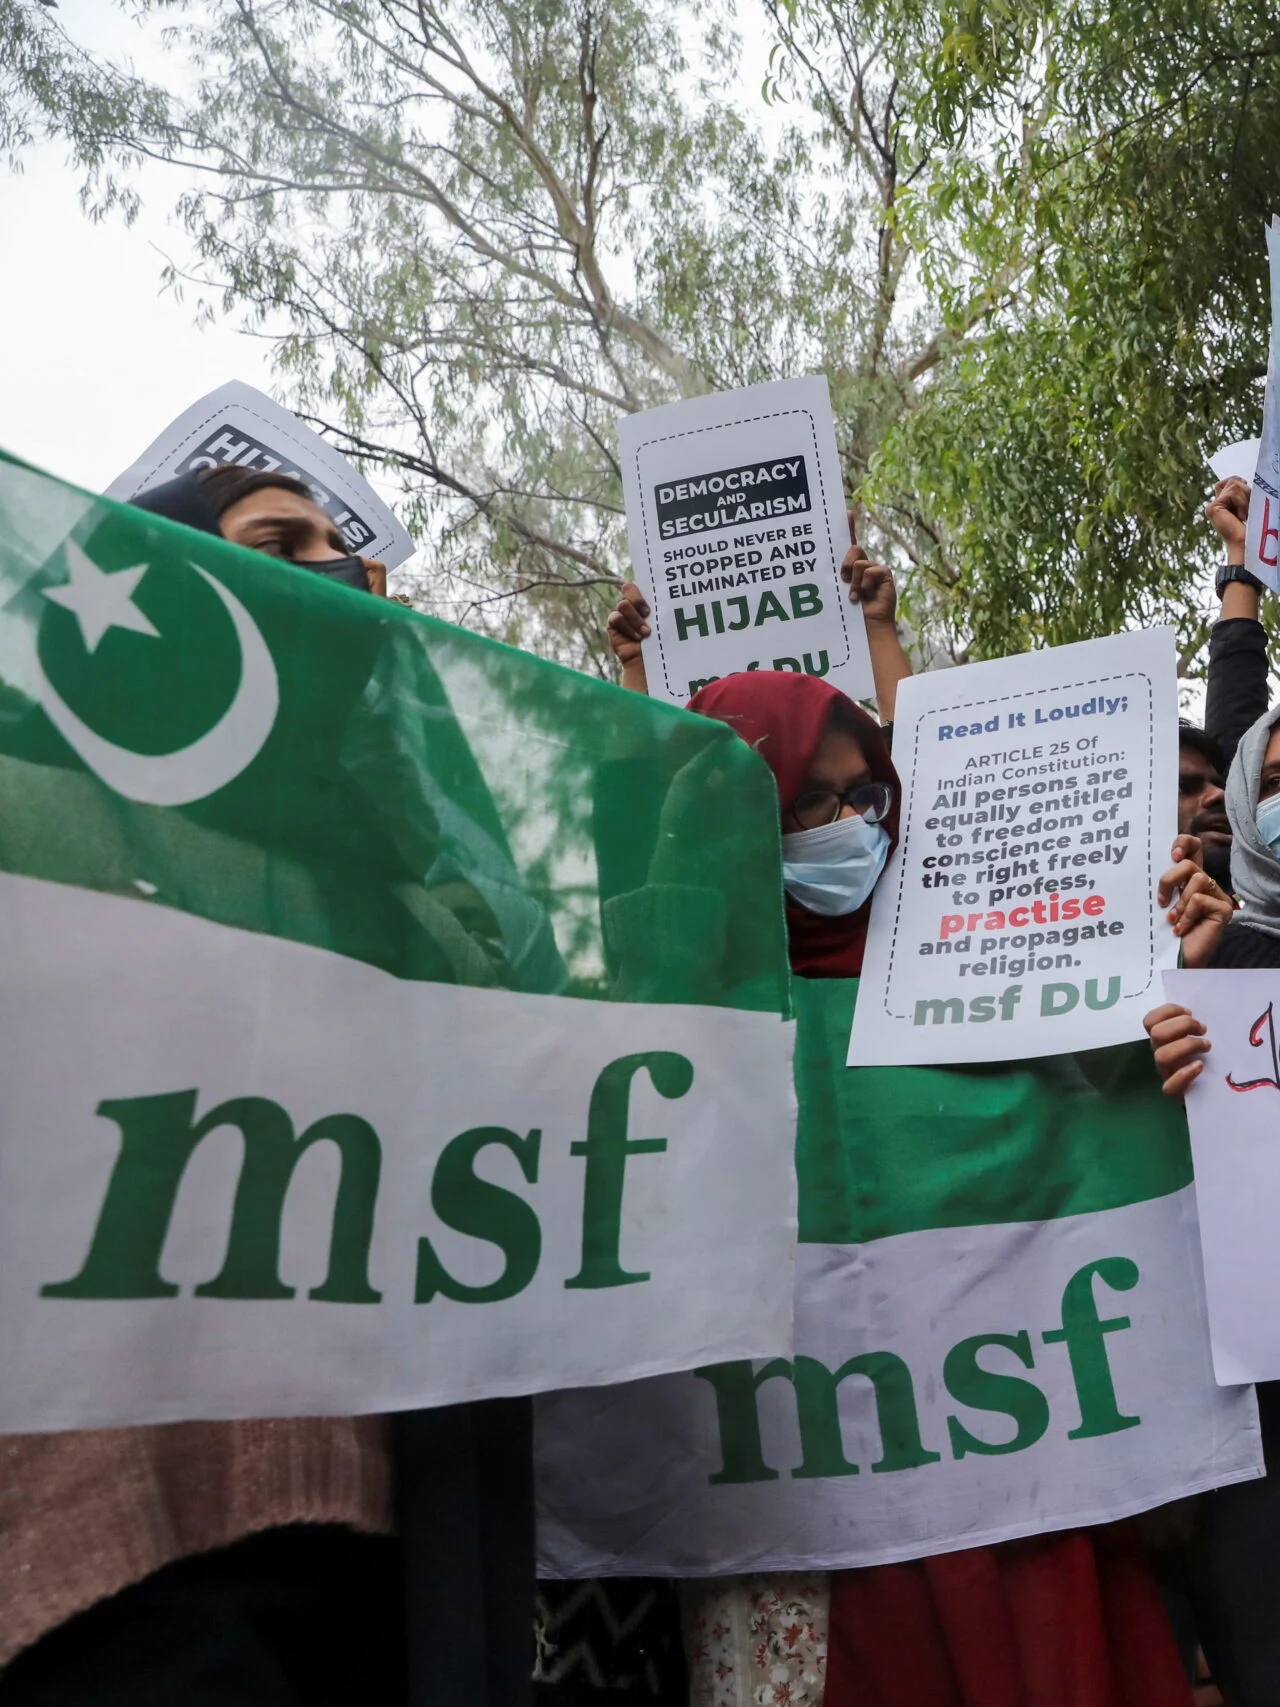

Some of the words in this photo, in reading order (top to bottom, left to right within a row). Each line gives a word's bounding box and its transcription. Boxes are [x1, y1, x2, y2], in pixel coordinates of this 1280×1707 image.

[659, 461, 801, 504] DEMOCRACY
[716, 492, 746, 507] AND
[661, 493, 807, 537] SECULARISM
[664, 540, 729, 563] SHOULD
[734, 529, 787, 548] NEVER
[792, 524, 813, 537] BE
[665, 551, 763, 582] STOPPED
[770, 540, 816, 561] AND
[668, 567, 786, 599] ELIMINATED
[793, 559, 818, 576] BY
[674, 583, 824, 641] HIJAB
[939, 716, 1000, 741] Read
[1008, 711, 1026, 729] It
[1035, 696, 1128, 724] Loudly;
[938, 771, 995, 791] Indian
[1002, 751, 1125, 780] Constitution:
[964, 746, 1043, 770] ARTICLE
[1050, 741, 1070, 756] 25
[1076, 735, 1098, 750] Of
[925, 803, 1021, 832] equally
[1029, 782, 1133, 814] entitled
[932, 791, 966, 810] All
[975, 775, 1078, 807] persons
[1086, 767, 1128, 785] are
[922, 834, 1072, 869] conscience
[1080, 821, 1130, 845] and
[936, 832, 962, 848] to
[971, 813, 1083, 844] freedom
[1092, 803, 1120, 822] of
[922, 872, 966, 888] the
[976, 858, 1039, 884] right
[1048, 845, 1128, 872] freely
[952, 890, 979, 905] to
[988, 872, 1096, 906] profess,
[919, 936, 970, 956] and
[980, 920, 1124, 954] propagate
[939, 893, 1106, 940] practise
[959, 952, 1081, 977] religion.
[914, 984, 1023, 1026] msf
[1040, 976, 1121, 1017] DU
[38, 1050, 694, 1305] msf
[693, 1256, 1141, 1485] msf
